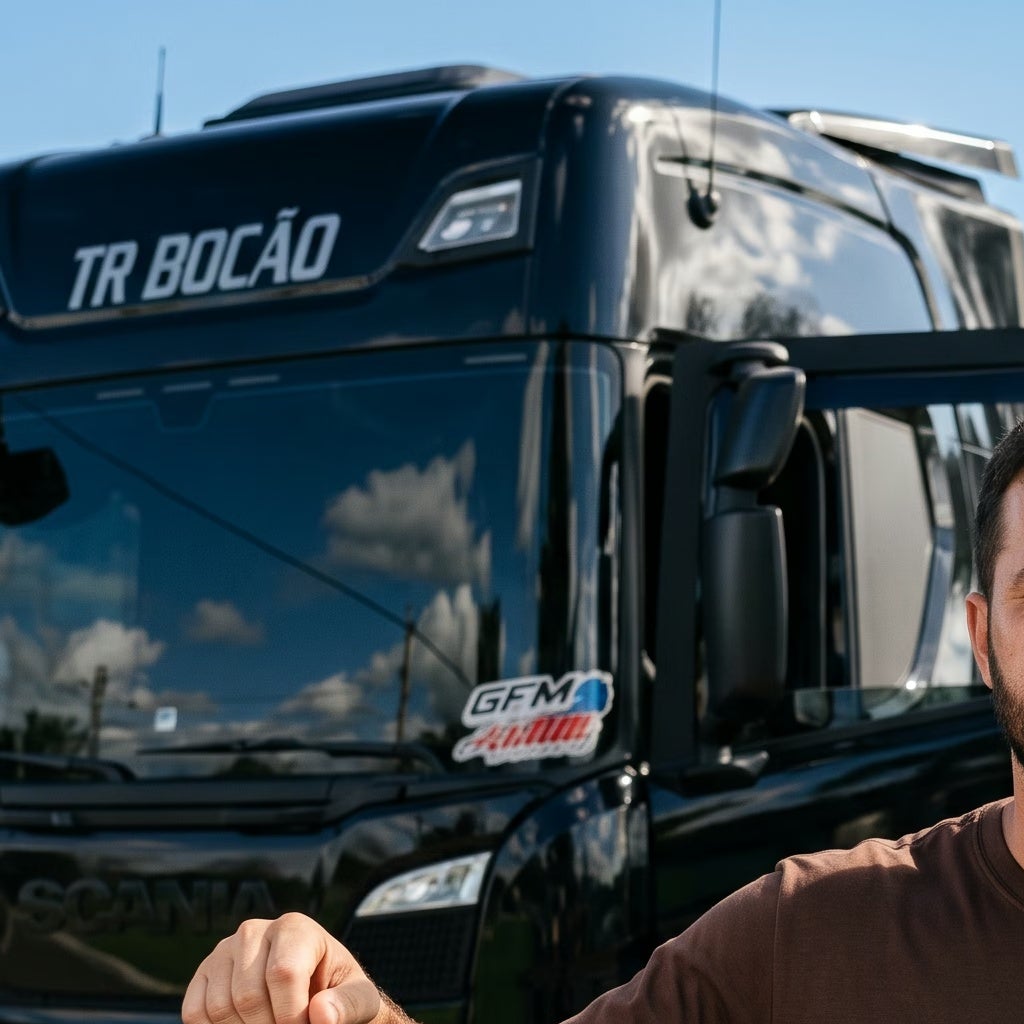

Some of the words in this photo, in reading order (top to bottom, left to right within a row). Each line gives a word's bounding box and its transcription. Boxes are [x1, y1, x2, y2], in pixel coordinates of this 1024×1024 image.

[68, 239, 138, 311] TR
[471, 678, 577, 715] GFM
[17, 876, 279, 934] SCANIA
